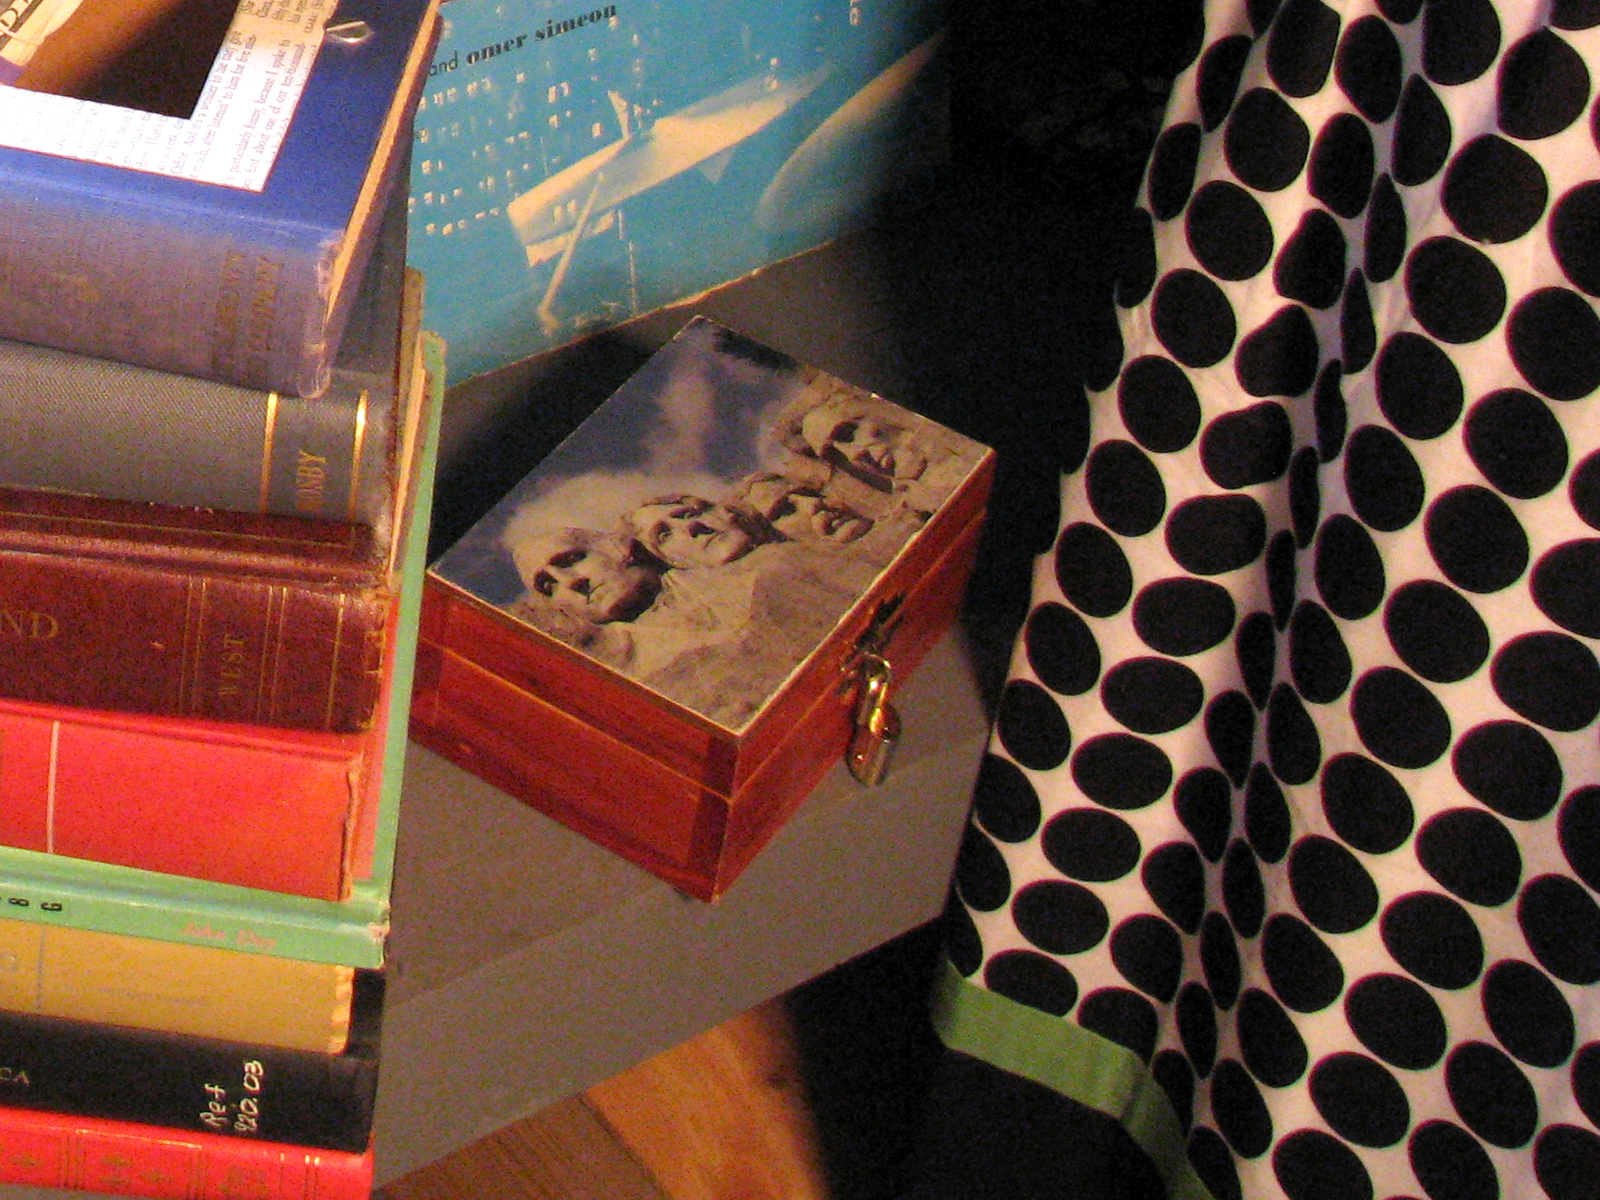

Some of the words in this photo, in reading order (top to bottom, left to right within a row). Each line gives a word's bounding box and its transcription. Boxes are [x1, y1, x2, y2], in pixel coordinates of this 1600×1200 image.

[429, 50, 460, 78] and
[465, 30, 528, 66] omer
[534, 1, 618, 44] simeon
